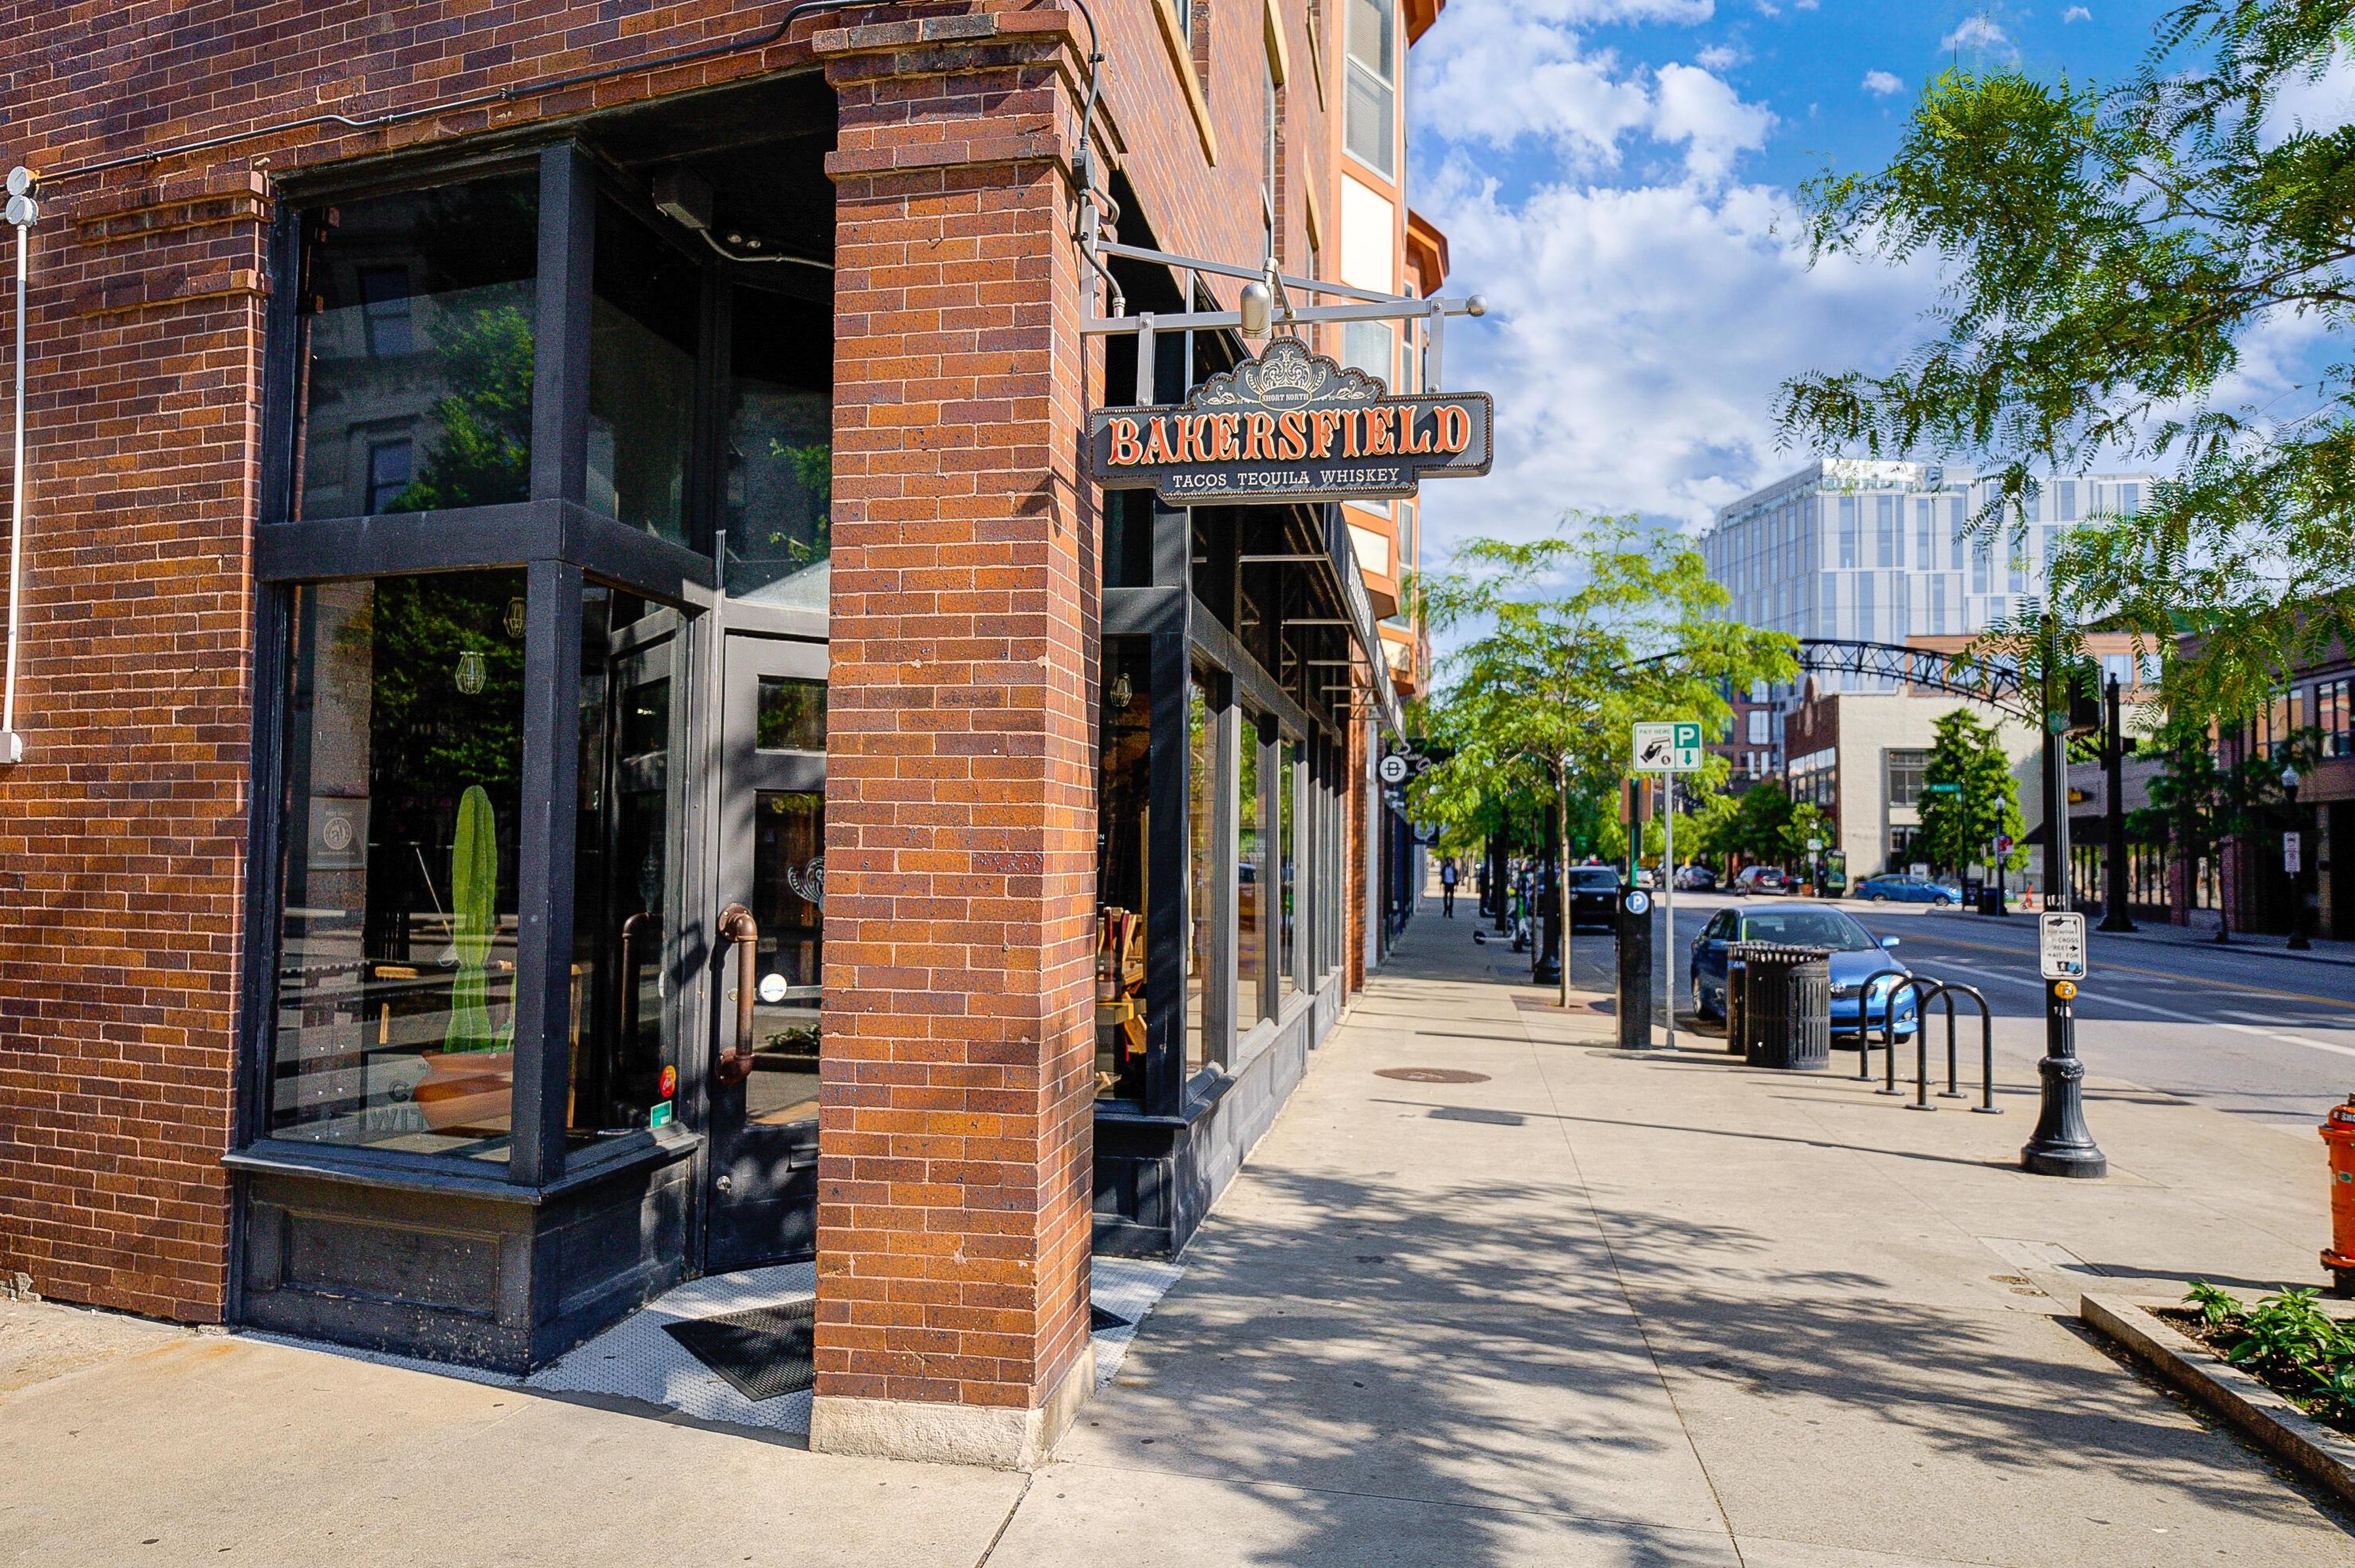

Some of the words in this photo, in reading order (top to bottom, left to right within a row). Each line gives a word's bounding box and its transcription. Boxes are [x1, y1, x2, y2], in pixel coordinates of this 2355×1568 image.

[1285, 393, 1310, 402] NORTH
[1107, 405, 1471, 466] BAKERSFIELD
[1172, 474, 1227, 488] TACOS
[1237, 471, 1311, 486] TEQUILA
[1319, 467, 1400, 484] WHISKEY
[1679, 727, 1695, 746] P
